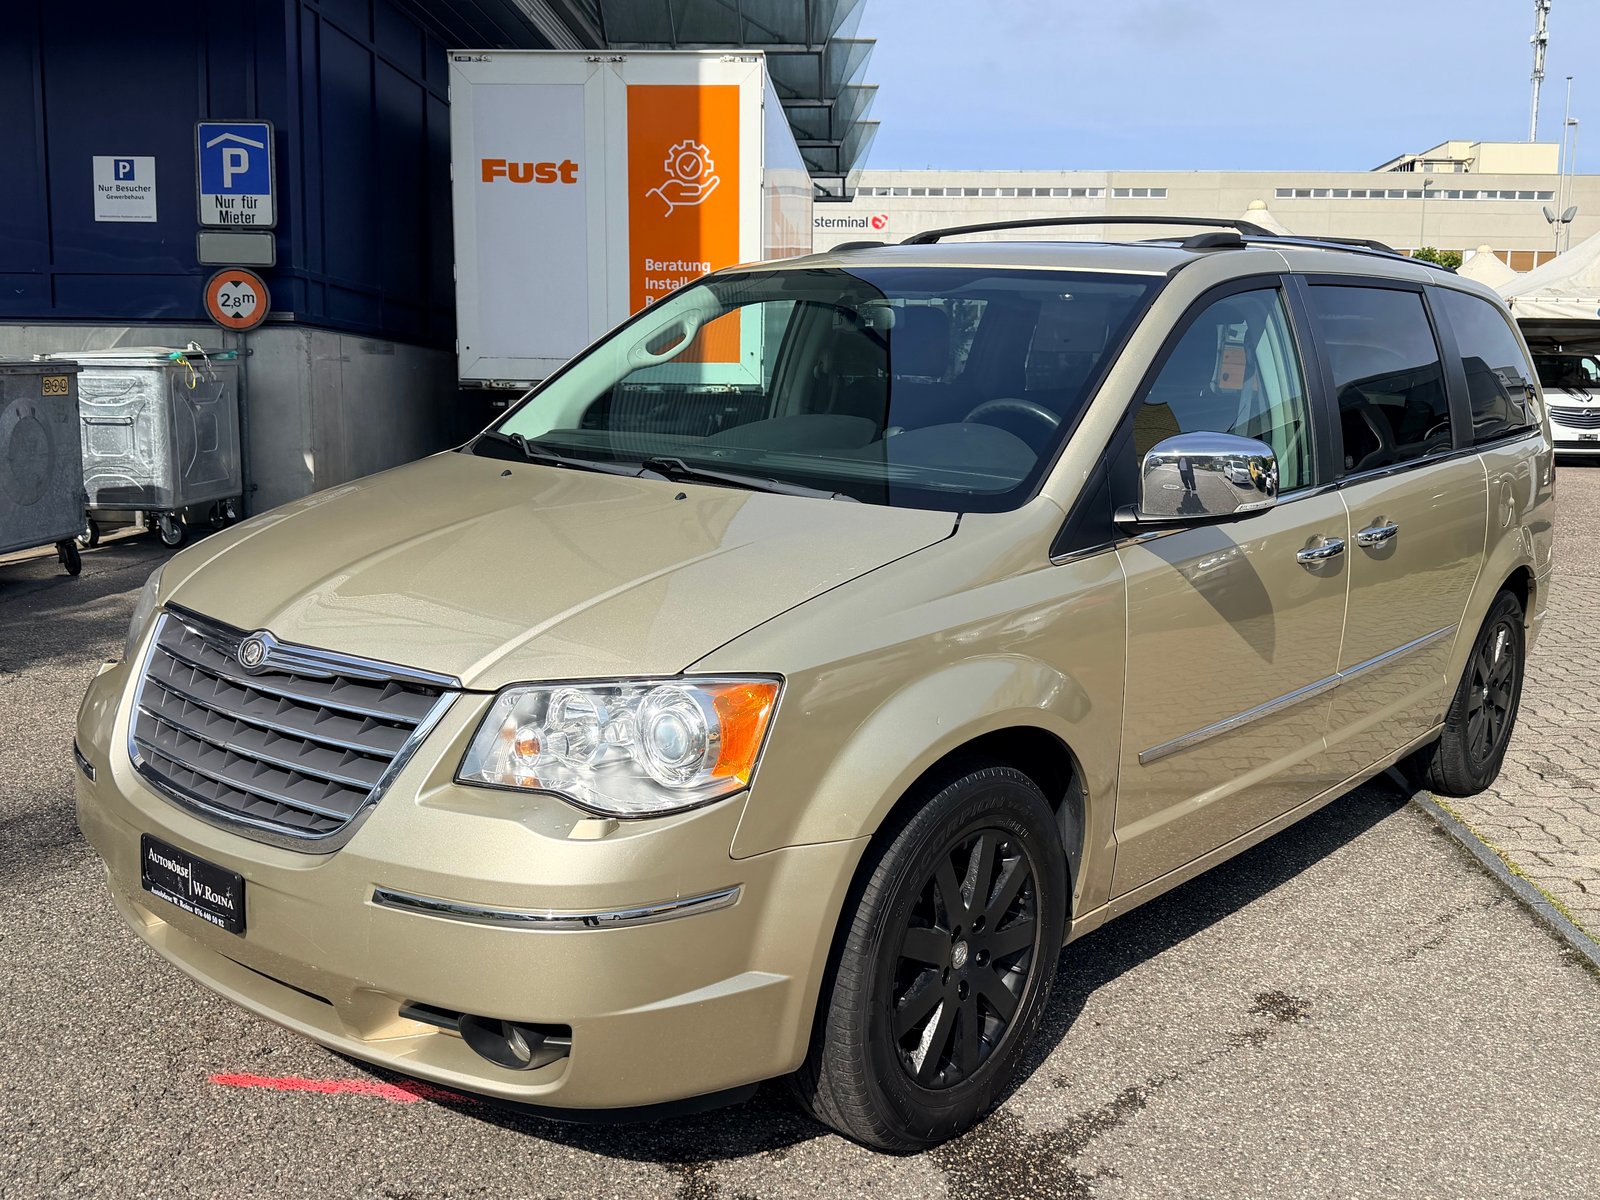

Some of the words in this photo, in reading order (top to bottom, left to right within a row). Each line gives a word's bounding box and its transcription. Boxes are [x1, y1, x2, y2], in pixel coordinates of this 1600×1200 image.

[118, 161, 131, 179] P
[223, 147, 249, 188] P
[481, 158, 579, 184] Fust
[98, 184, 112, 192] Nur
[115, 184, 152, 192] Besucher
[215, 194, 236, 209] Nur
[241, 195, 258, 209] für
[219, 210, 257, 224] Mieter
[814, 216, 869, 228] sterminal
[645, 258, 711, 275] Beratung
[645, 276, 688, 290] Install
